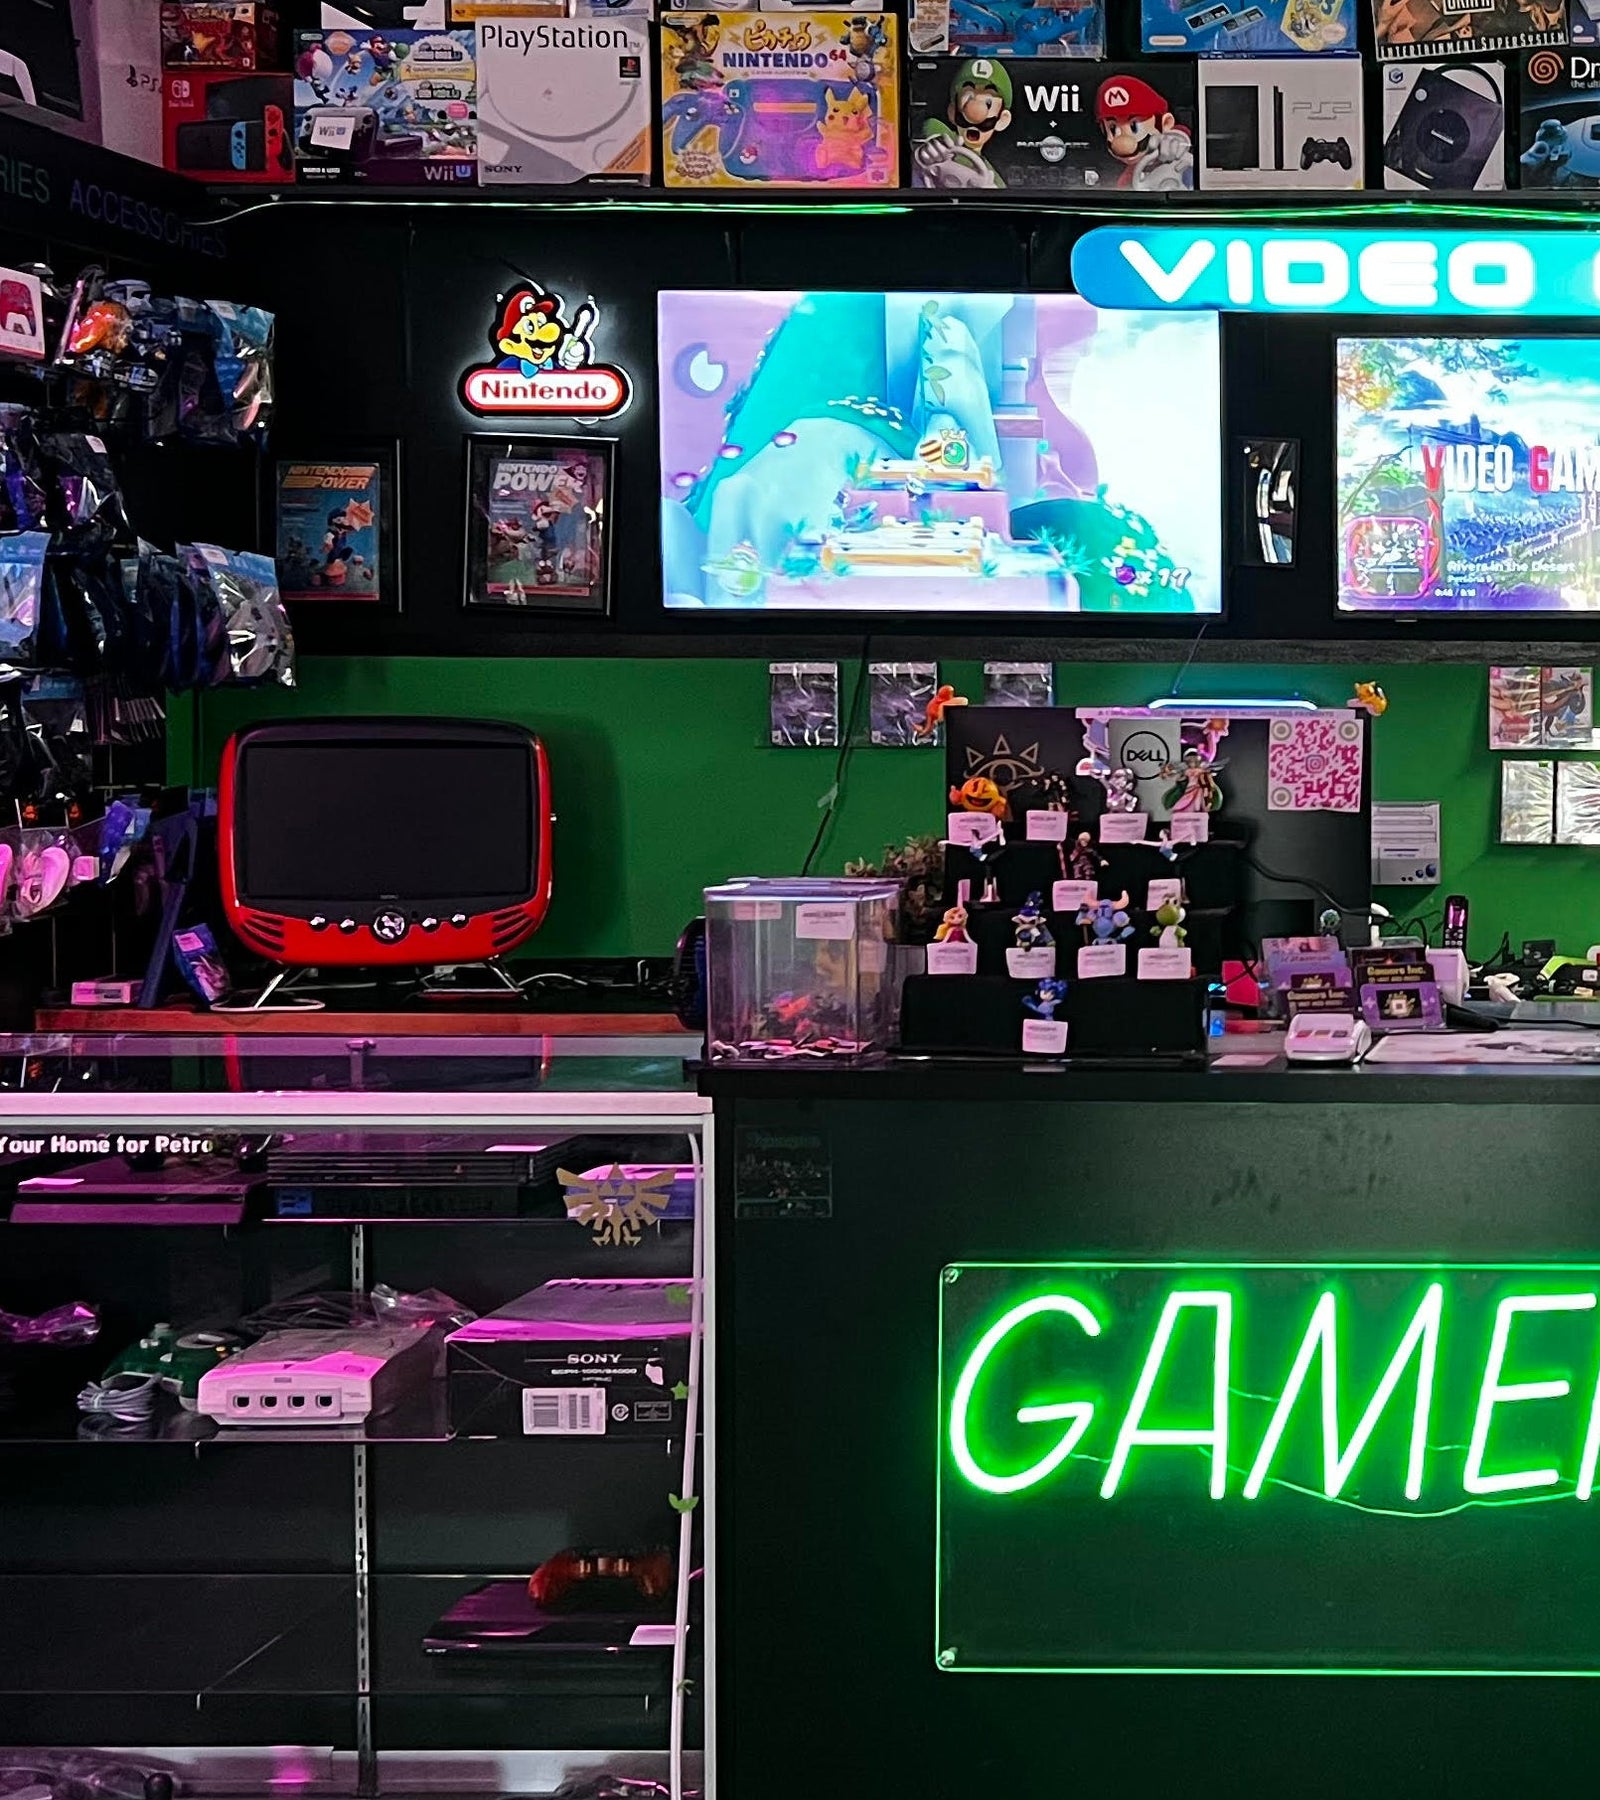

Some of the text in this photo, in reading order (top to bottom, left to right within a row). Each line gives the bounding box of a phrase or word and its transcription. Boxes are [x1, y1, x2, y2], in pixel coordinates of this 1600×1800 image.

[481, 25, 628, 56] PlayStation
[722, 49, 848, 68] NINTENDO 64
[1571, 80, 1585, 88] the
[1024, 85, 1080, 112] Wii
[1292, 102, 1353, 114] PS2
[424, 165, 455, 181] Wii
[485, 165, 523, 174] SONY
[1120, 239, 1536, 307] VIDEO
[480, 380, 607, 400] Nintendo
[497, 463, 558, 474] NINTENDO
[1421, 444, 1514, 493] VIDEO
[314, 476, 370, 490] POWER
[1127, 750, 1164, 762] DELL
[0, 1135, 45, 1154] Your
[50, 1135, 110, 1154] Home
[117, 1135, 149, 1154] for
[567, 1353, 622, 1364] SONY
